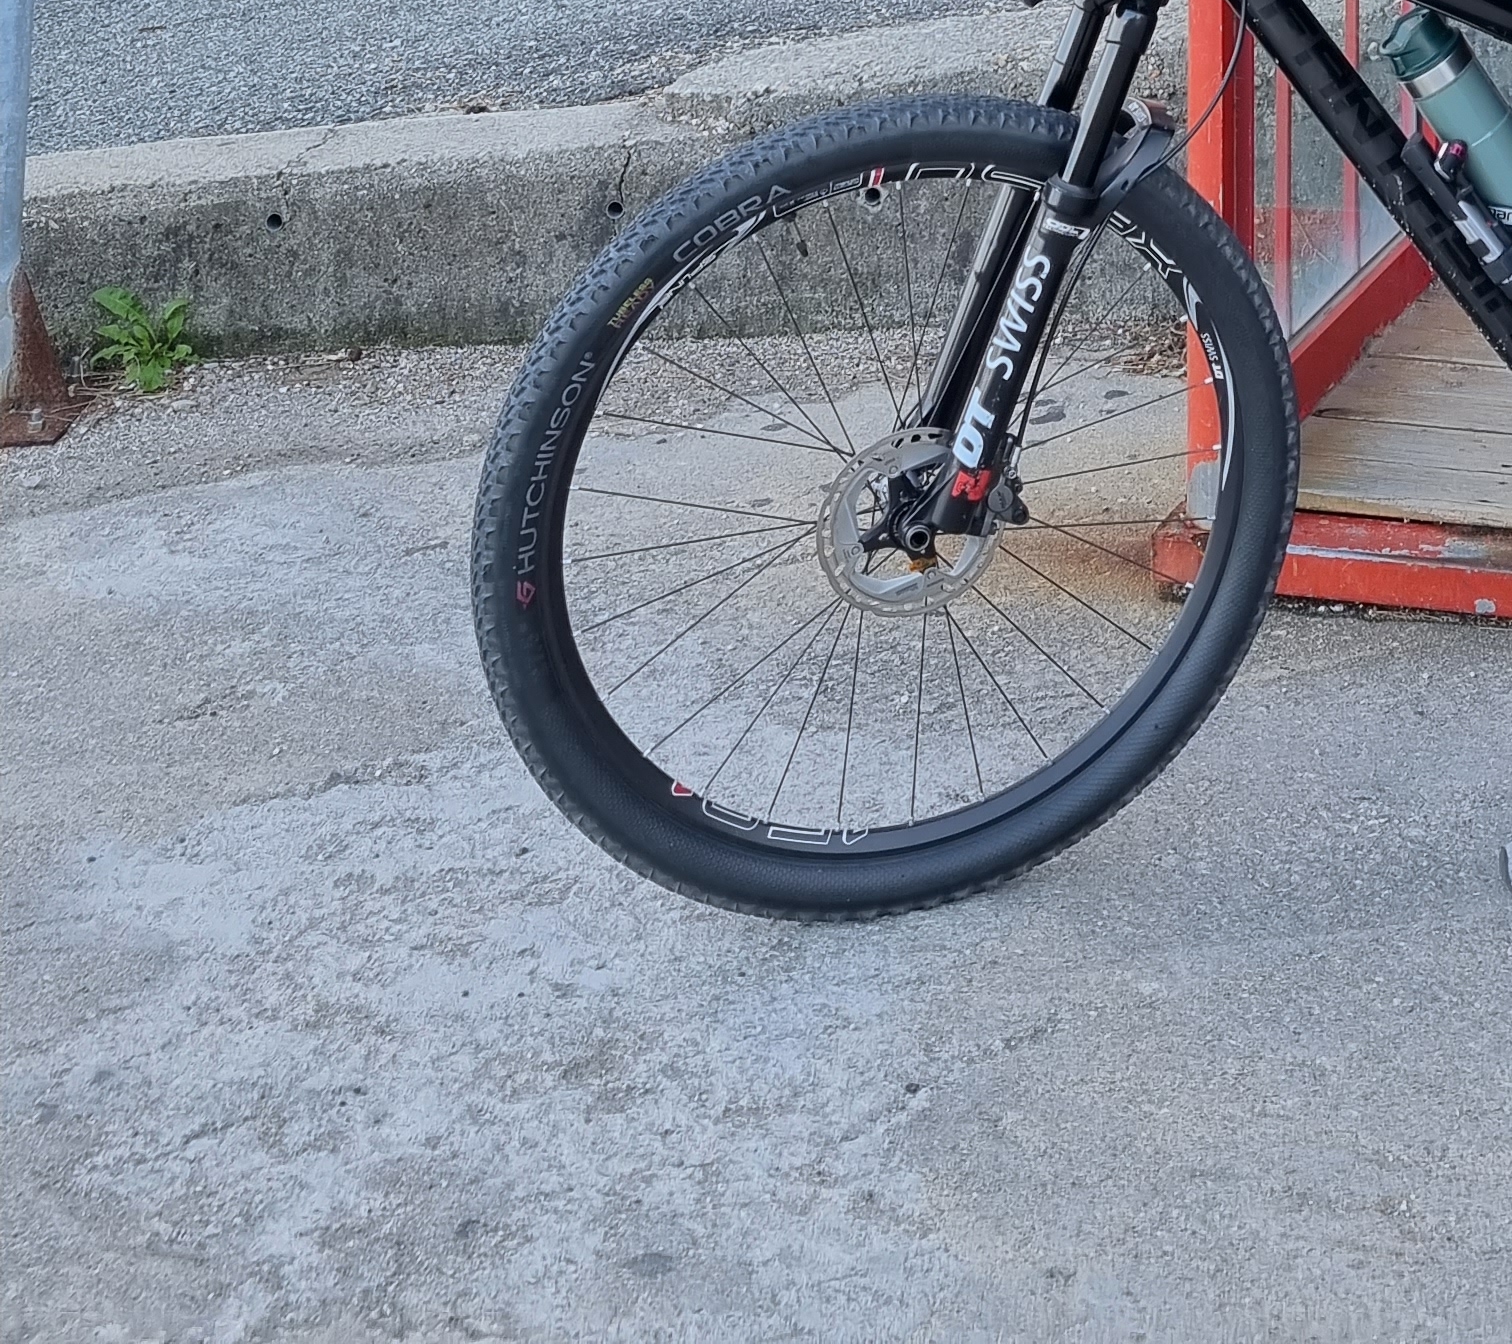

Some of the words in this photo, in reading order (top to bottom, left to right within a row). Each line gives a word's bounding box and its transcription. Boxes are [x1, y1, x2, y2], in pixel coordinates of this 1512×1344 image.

[672, 184, 792, 263] COBRA
[952, 386, 996, 469] DT
[986, 244, 1051, 381] SWISS
